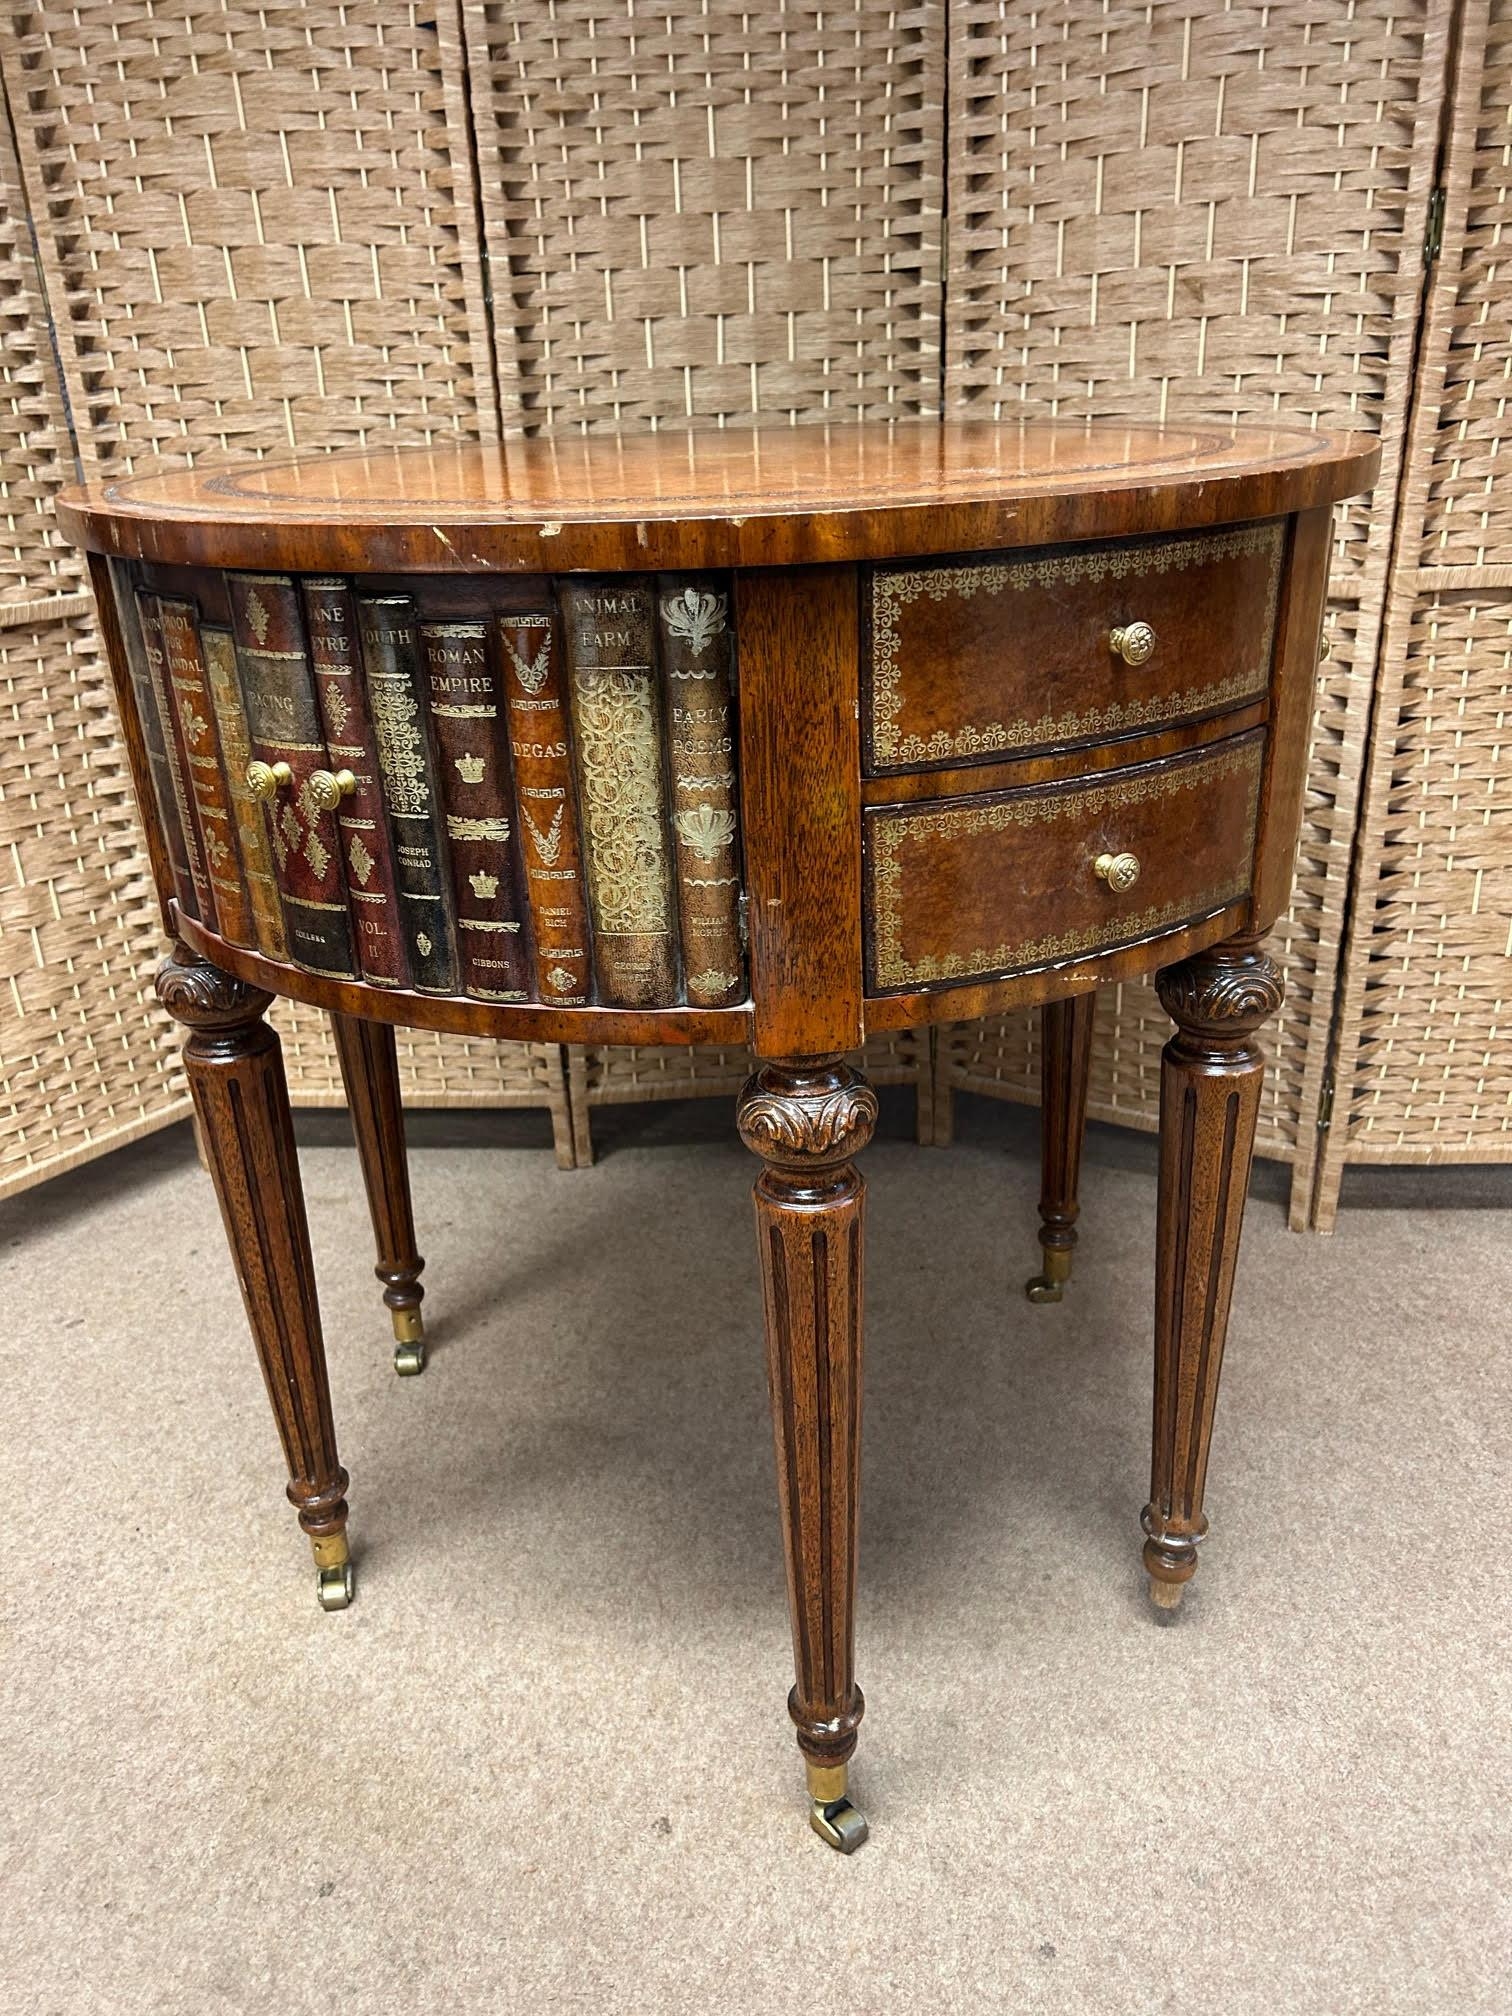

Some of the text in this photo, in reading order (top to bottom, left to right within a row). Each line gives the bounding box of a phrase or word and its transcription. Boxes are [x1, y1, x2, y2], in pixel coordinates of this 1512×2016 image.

[576, 597, 643, 614] ANIMAL
[311, 607, 344, 622] ANE
[363, 629, 413, 645] OUTH
[582, 631, 631, 648] FARM
[427, 647, 486, 664] ROMAN
[430, 676, 494, 693] EMPIRE
[672, 705, 728, 724] EARLY
[511, 741, 567, 758] DEGAS
[672, 737, 732, 755] POEMS
[397, 845, 429, 857] JOSEPH
[398, 856, 432, 868] CONRAD
[539, 906, 572, 916] DANIEL
[358, 919, 388, 936] VOL.
[544, 918, 568, 928] RICH
[690, 915, 729, 925] WILLIAM
[692, 928, 729, 937] MORRIS
[472, 957, 511, 969] GIBBONS
